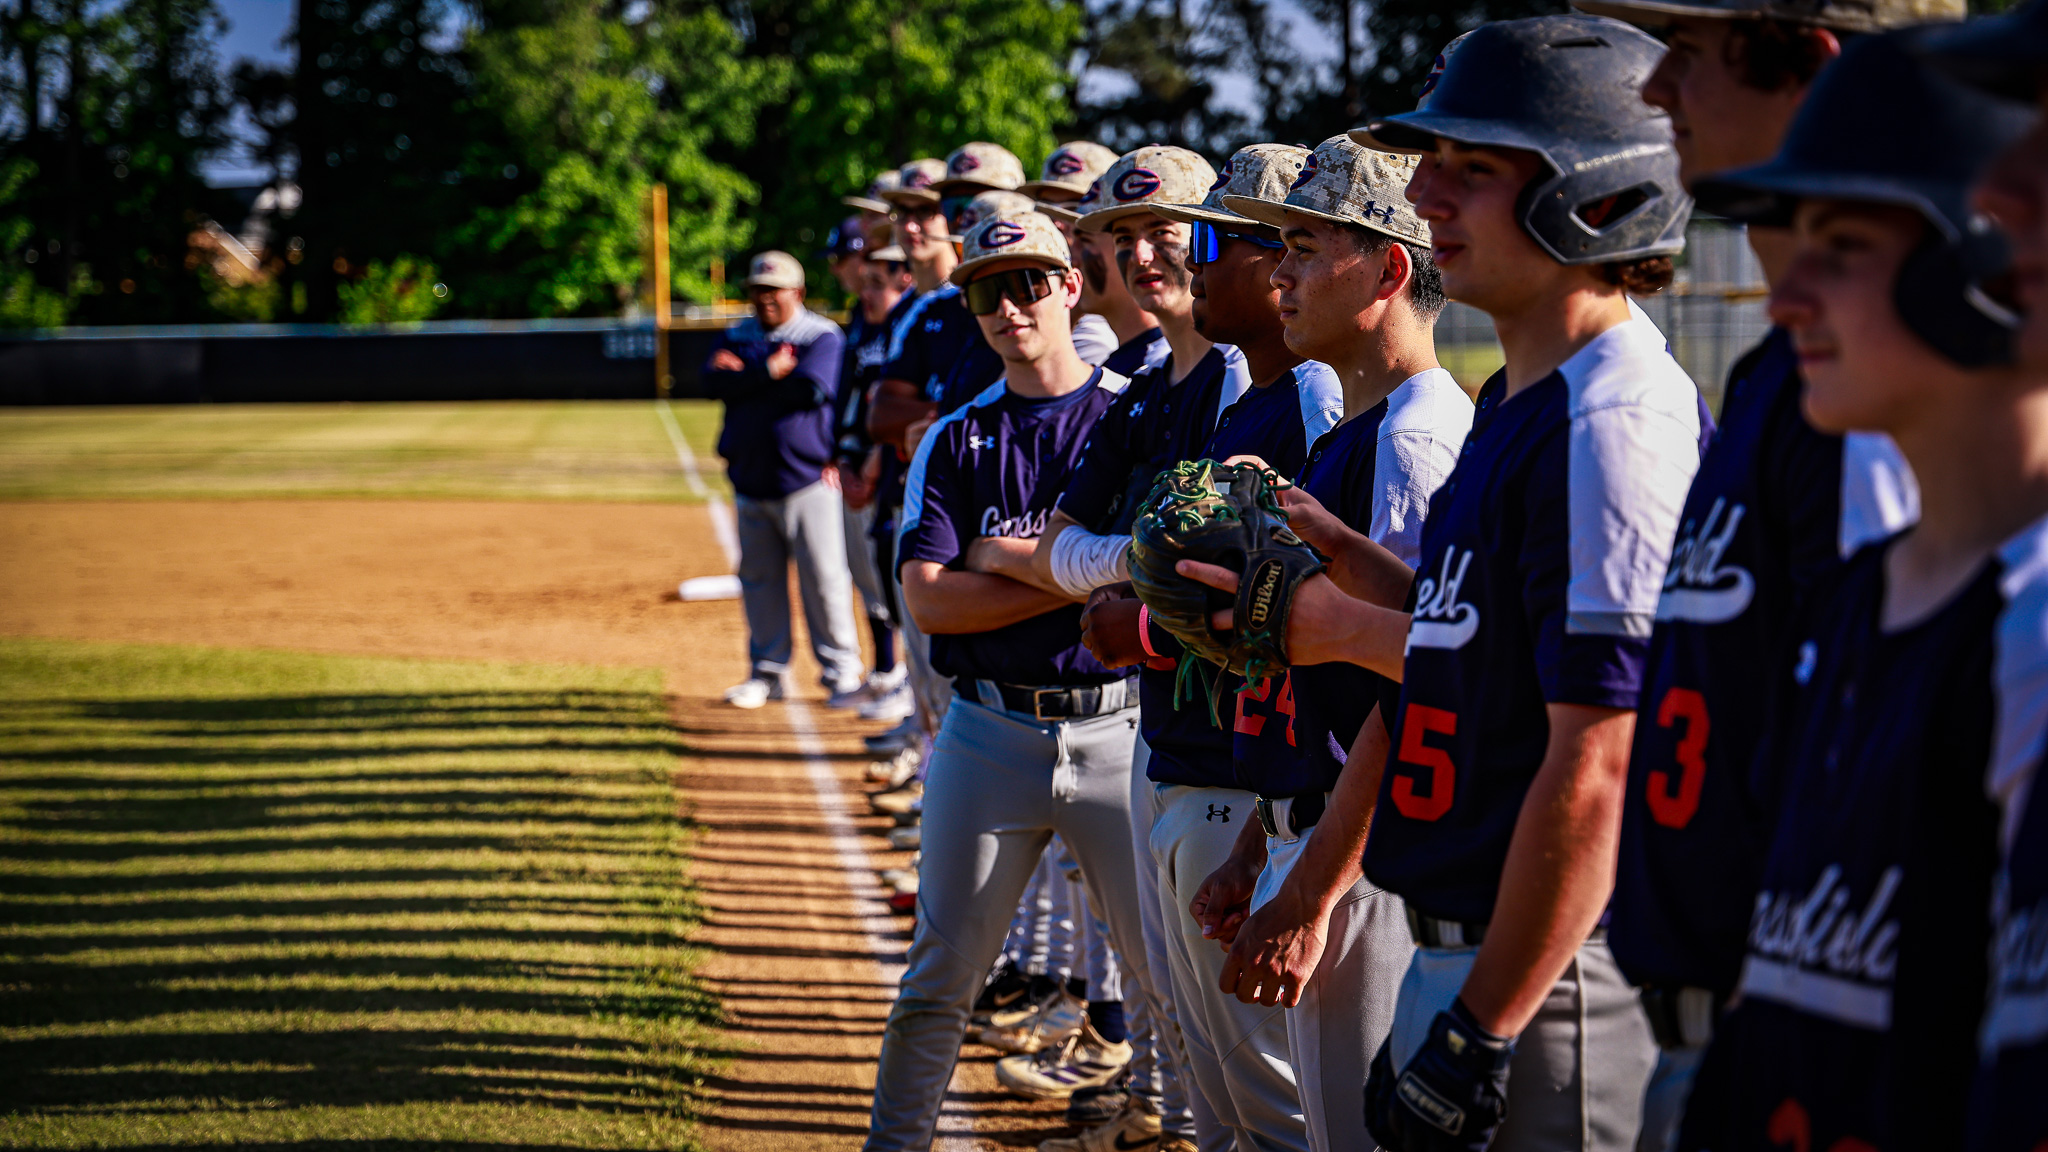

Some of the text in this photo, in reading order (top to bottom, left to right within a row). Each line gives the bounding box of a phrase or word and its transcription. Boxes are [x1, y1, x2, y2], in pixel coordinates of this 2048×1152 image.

[1113, 167, 1163, 202] G
[978, 221, 1027, 249] G
[1251, 563, 1283, 623] Wilson
[1390, 702, 1458, 823] 5
[1645, 686, 1711, 831] 3
